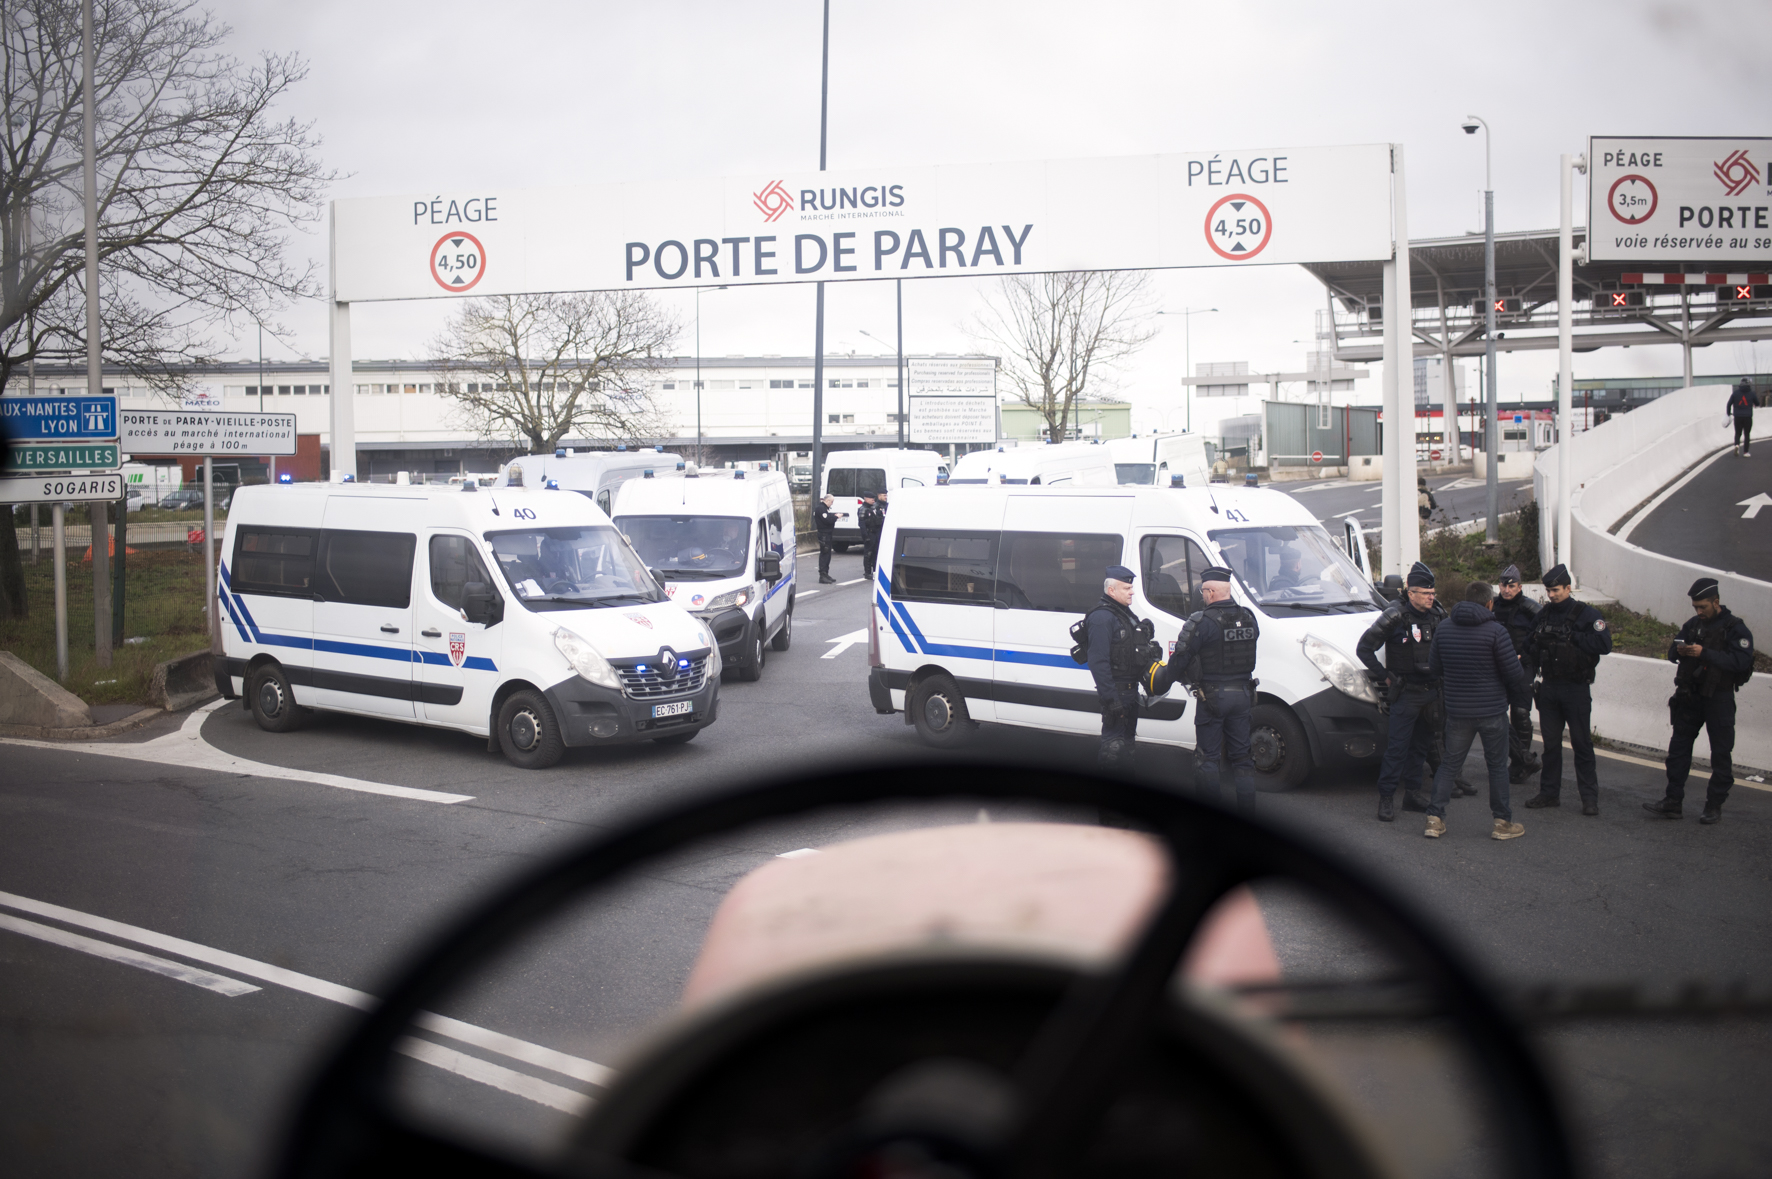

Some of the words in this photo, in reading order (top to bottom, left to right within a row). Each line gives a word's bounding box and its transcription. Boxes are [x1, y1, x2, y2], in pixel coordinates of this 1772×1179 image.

[1604, 149, 1663, 167] PÉAGE
[1187, 153, 1289, 187] PÉAGE
[800, 184, 905, 211] RUNGIS
[413, 195, 498, 225] PÉAGE
[800, 213, 835, 221] MARCHÉ
[837, 210, 905, 220] INTERNATIONAL
[1679, 206, 1769, 229] PORTE
[1214, 218, 1261, 239] 4,50
[1615, 233, 1648, 248] voie
[1653, 234, 1723, 248] réservée
[1729, 237, 1748, 249] au
[625, 235, 778, 282] PORTE
[794, 231, 857, 274] DE
[874, 223, 1034, 271] PARAY
[438, 253, 477, 272] 4,50
[41, 419, 78, 433] LYON
[124, 415, 159, 425] PORTE
[176, 417, 293, 428] PARAY-VIEILLE-POSTE
[127, 427, 159, 438] accès
[163, 429, 177, 438] au
[181, 427, 219, 438] marché
[223, 429, 291, 439] international
[173, 440, 205, 451] péage
[209, 440, 216, 449] à
[15, 450, 113, 465] VERSAILLES
[43, 480, 117, 496] SOGARIS
[513, 508, 537, 520] 40
[1226, 509, 1250, 522] 41
[1225, 628, 1253, 640] CRS
[450, 642, 464, 651] CRS
